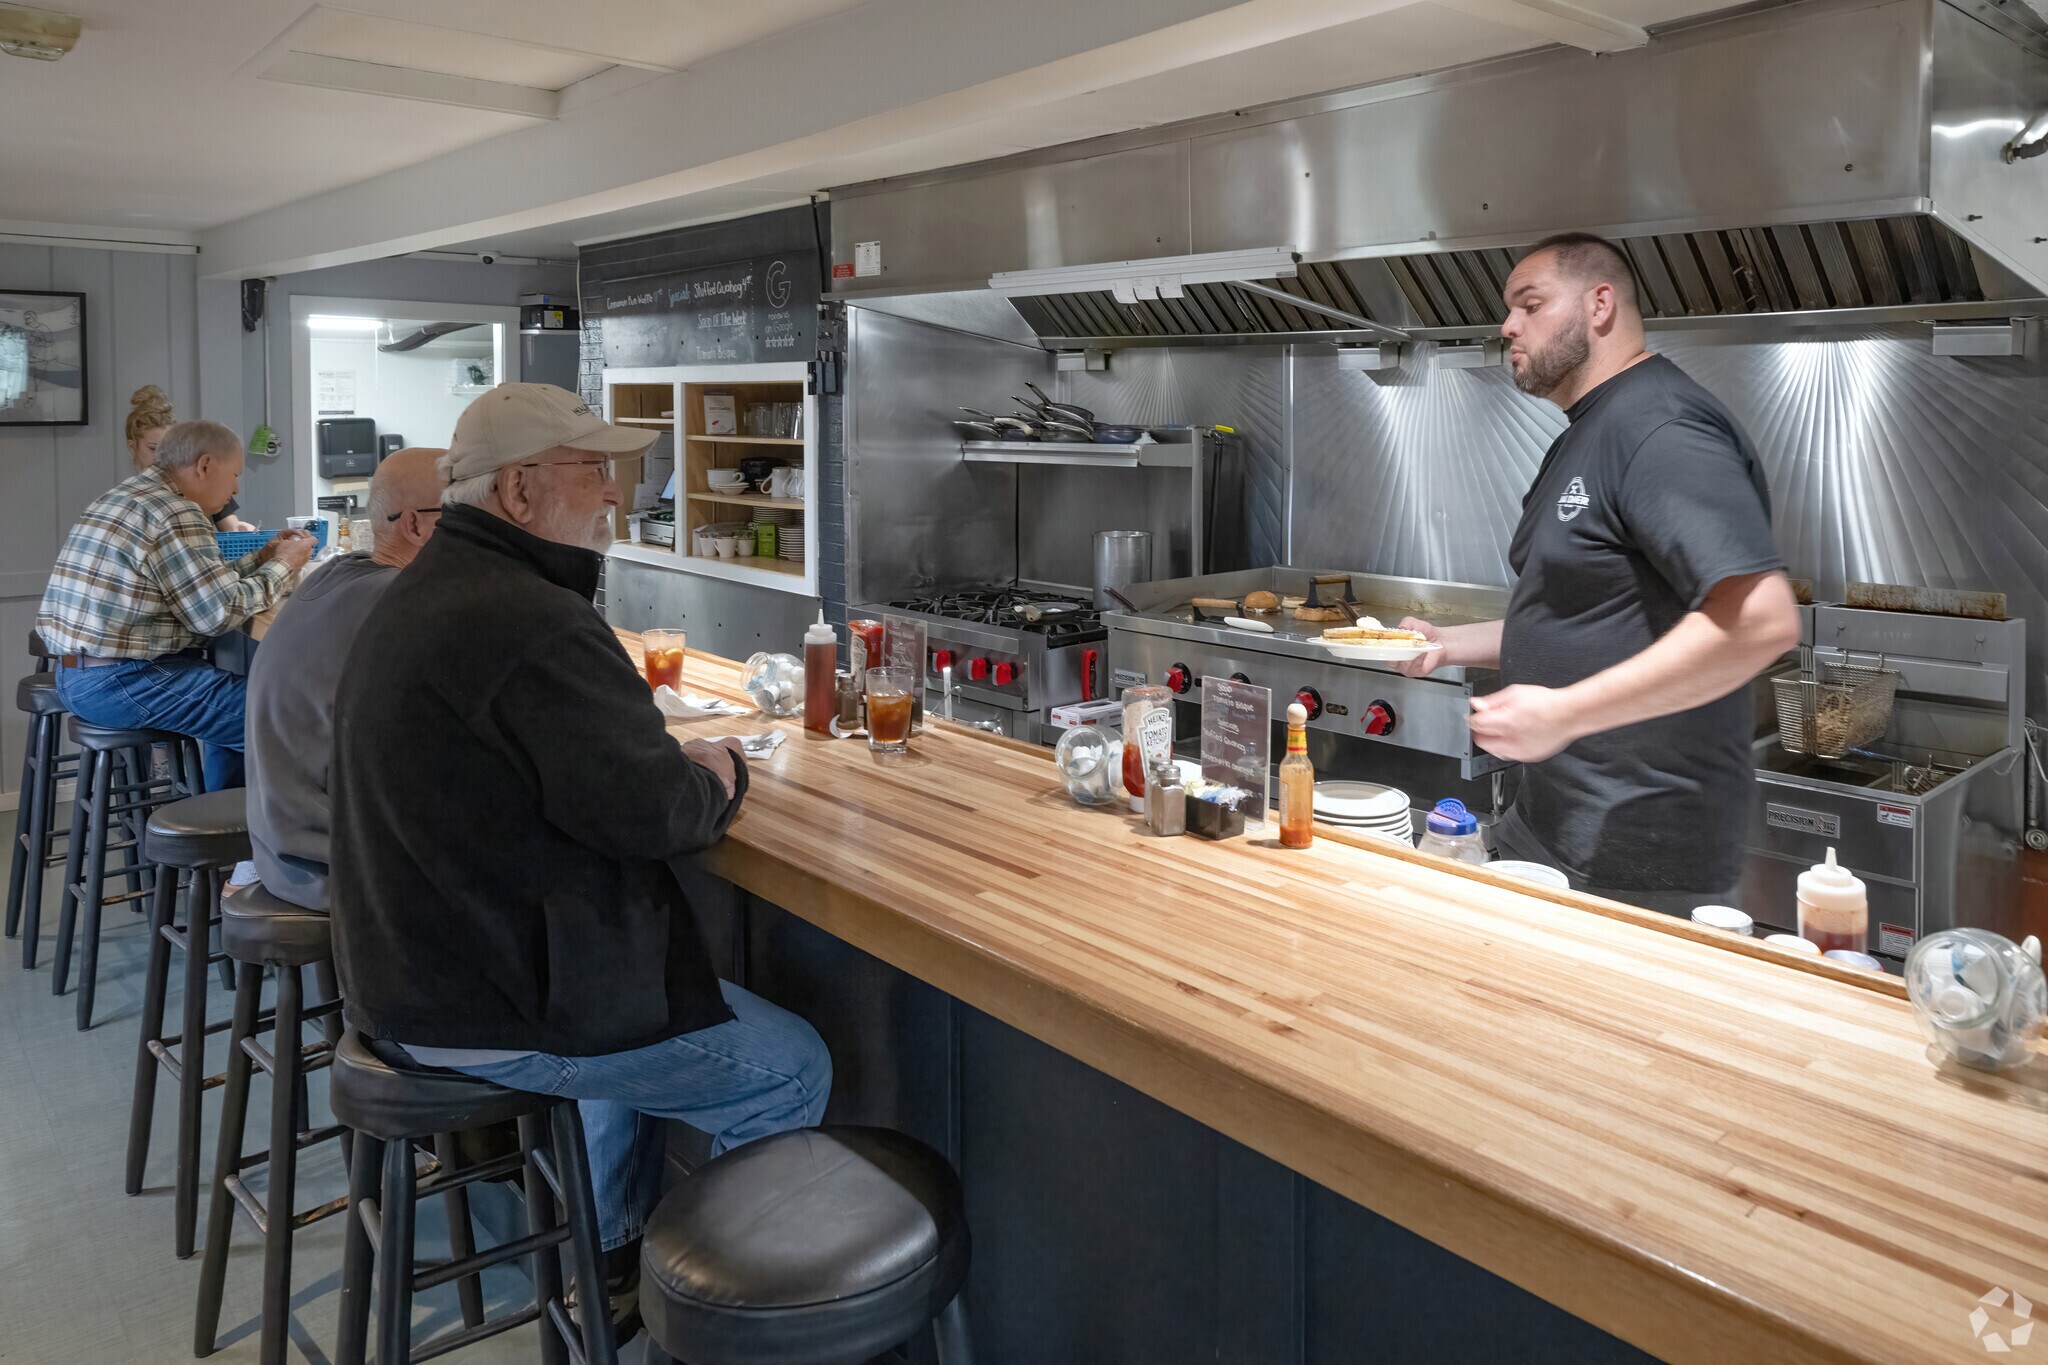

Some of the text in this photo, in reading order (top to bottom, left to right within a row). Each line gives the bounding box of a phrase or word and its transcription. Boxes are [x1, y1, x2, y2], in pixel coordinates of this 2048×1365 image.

[693, 281, 716, 299] Stuffed
[1147, 713, 1166, 726] HEINZ
[1144, 726, 1168, 740] TOMATO
[1146, 738, 1168, 748] KETCHUP
[1768, 809, 1814, 827] PRECISION
